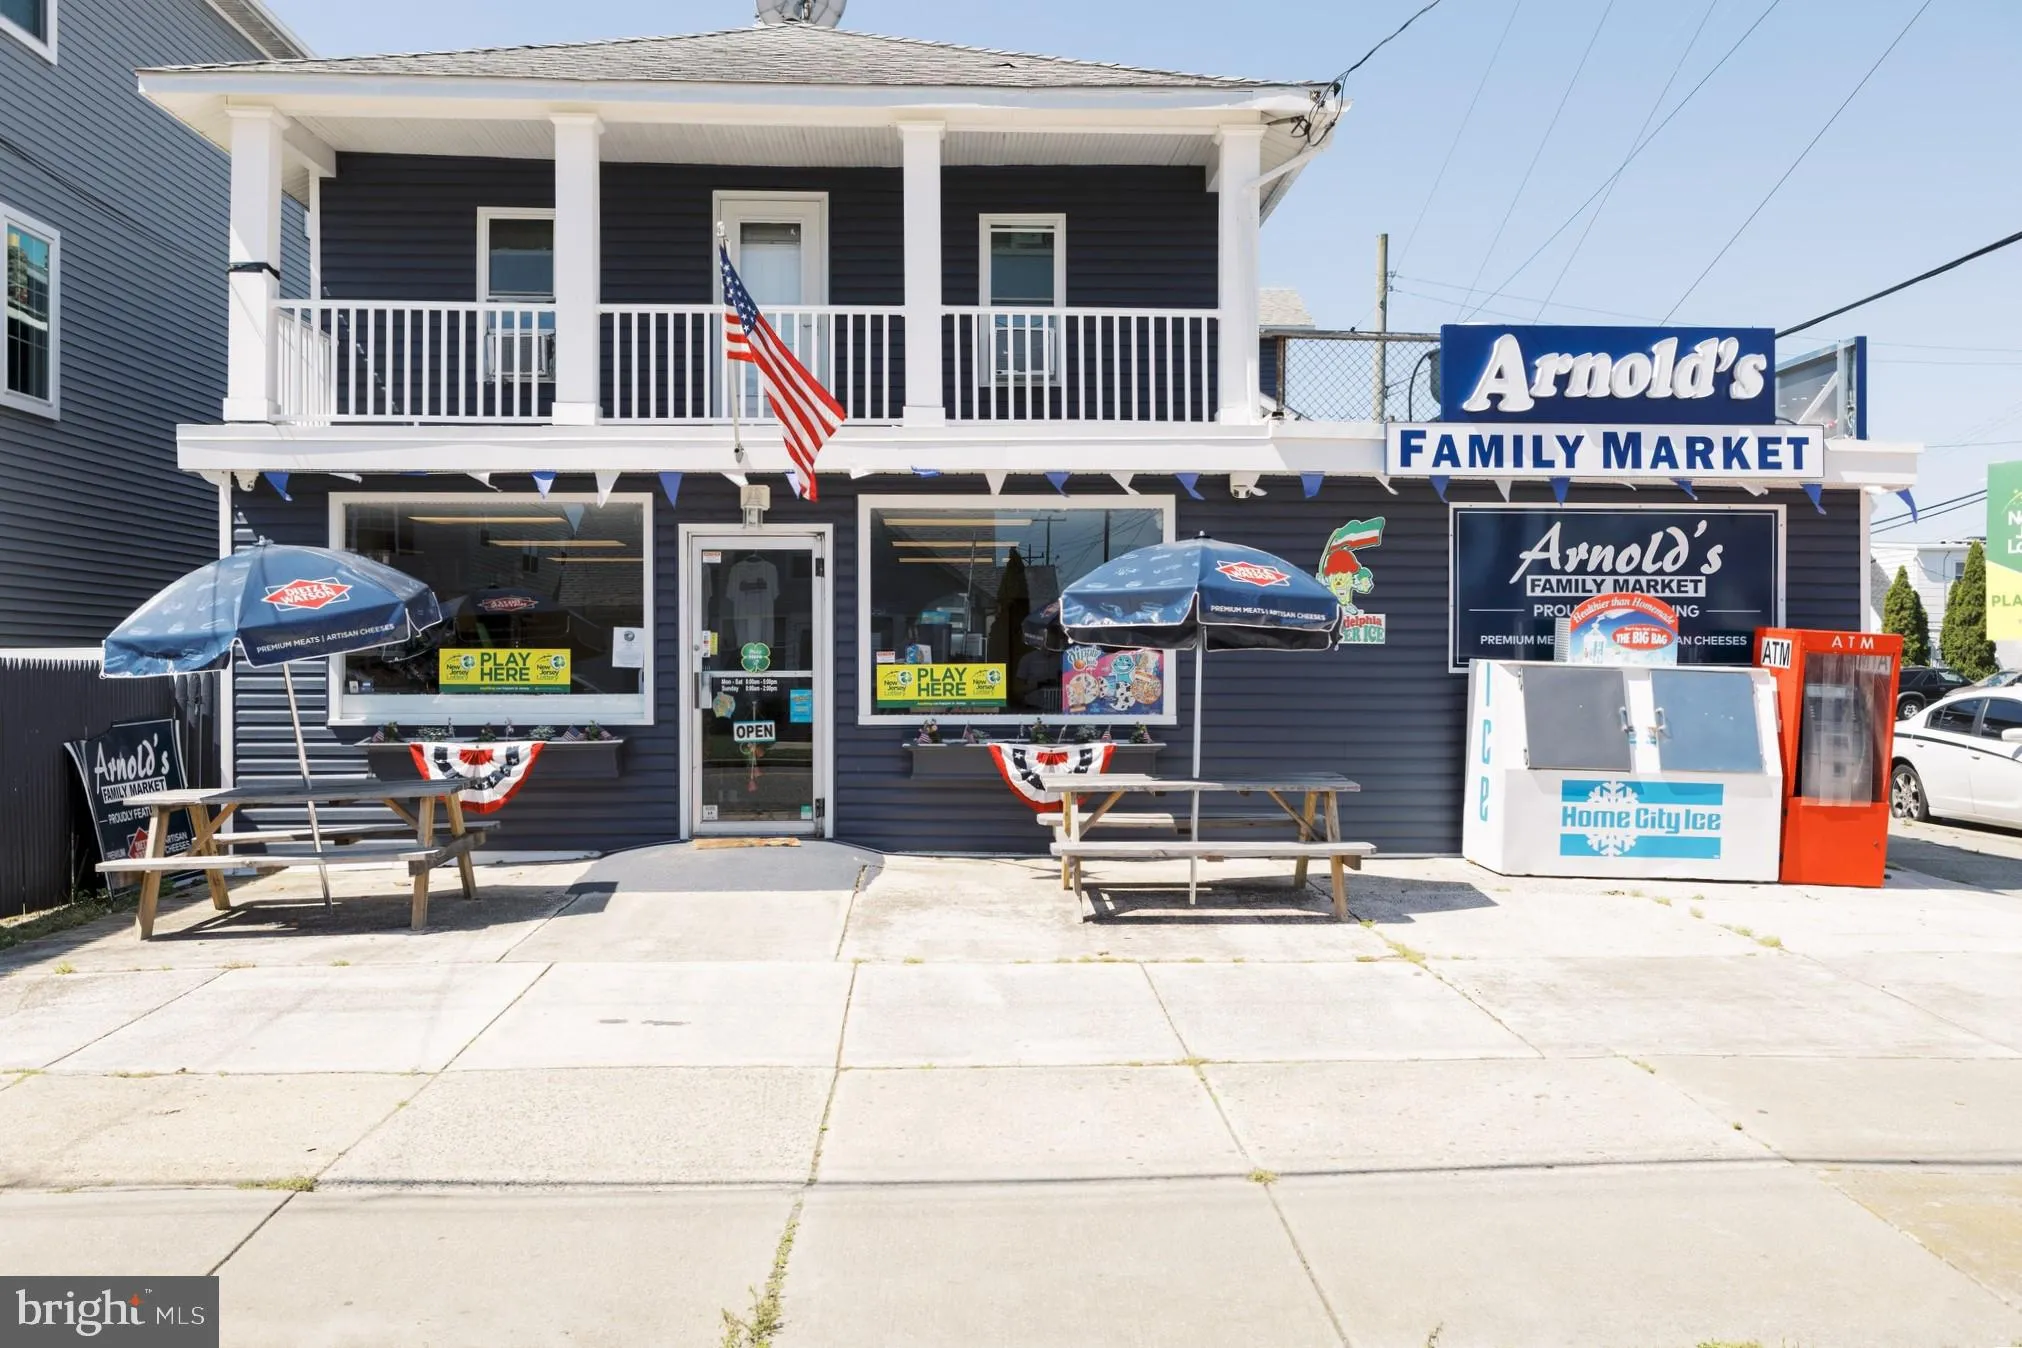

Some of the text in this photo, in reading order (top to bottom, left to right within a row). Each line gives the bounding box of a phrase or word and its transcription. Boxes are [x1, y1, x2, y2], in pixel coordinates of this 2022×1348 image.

[1462, 333, 1767, 412] Arnold's
[1400, 429, 1810, 470] FAMILY MARKET
[1509, 519, 1723, 584] Arnold's
[1530, 578, 1703, 594] FAMILY MARKET
[280, 588, 336, 604] WATSON
[1992, 595, 2022, 607] PLA
[1210, 605, 1242, 613] PREMIUM
[1269, 610, 1295, 618] ARTISAN
[1297, 613, 1326, 621] CHEESES
[1534, 604, 1575, 617] PROU
[1573, 599, 1610, 623] Healthier
[1611, 598, 1630, 607] than
[1633, 597, 1675, 625] Homemade
[1344, 615, 1382, 628] delphia
[256, 640, 292, 654] PREMIUM
[293, 636, 320, 647] MEATS
[326, 630, 358, 642] ARTISAN
[360, 623, 395, 635] CHEESES
[1363, 625, 1385, 642] ICE
[1480, 635, 1534, 645] PREMIUM
[1616, 633, 1630, 645] THE
[1632, 631, 1650, 644] BIG
[1651, 632, 1668, 645] BAG
[1694, 635, 1747, 646] CHEESES
[1831, 635, 1874, 649] ATM
[480, 652, 531, 667] PLAY
[1763, 641, 1790, 667] ATM
[480, 667, 530, 681] HERE
[917, 668, 967, 682] PLAY
[917, 682, 967, 696] HERE
[736, 724, 773, 738] OPEN
[94, 733, 170, 795] Arnold's
[103, 779, 165, 801] FAMILY MARKET
[108, 806, 152, 825] PROUDLY FEATU
[1561, 806, 1721, 834] Home City Ice
